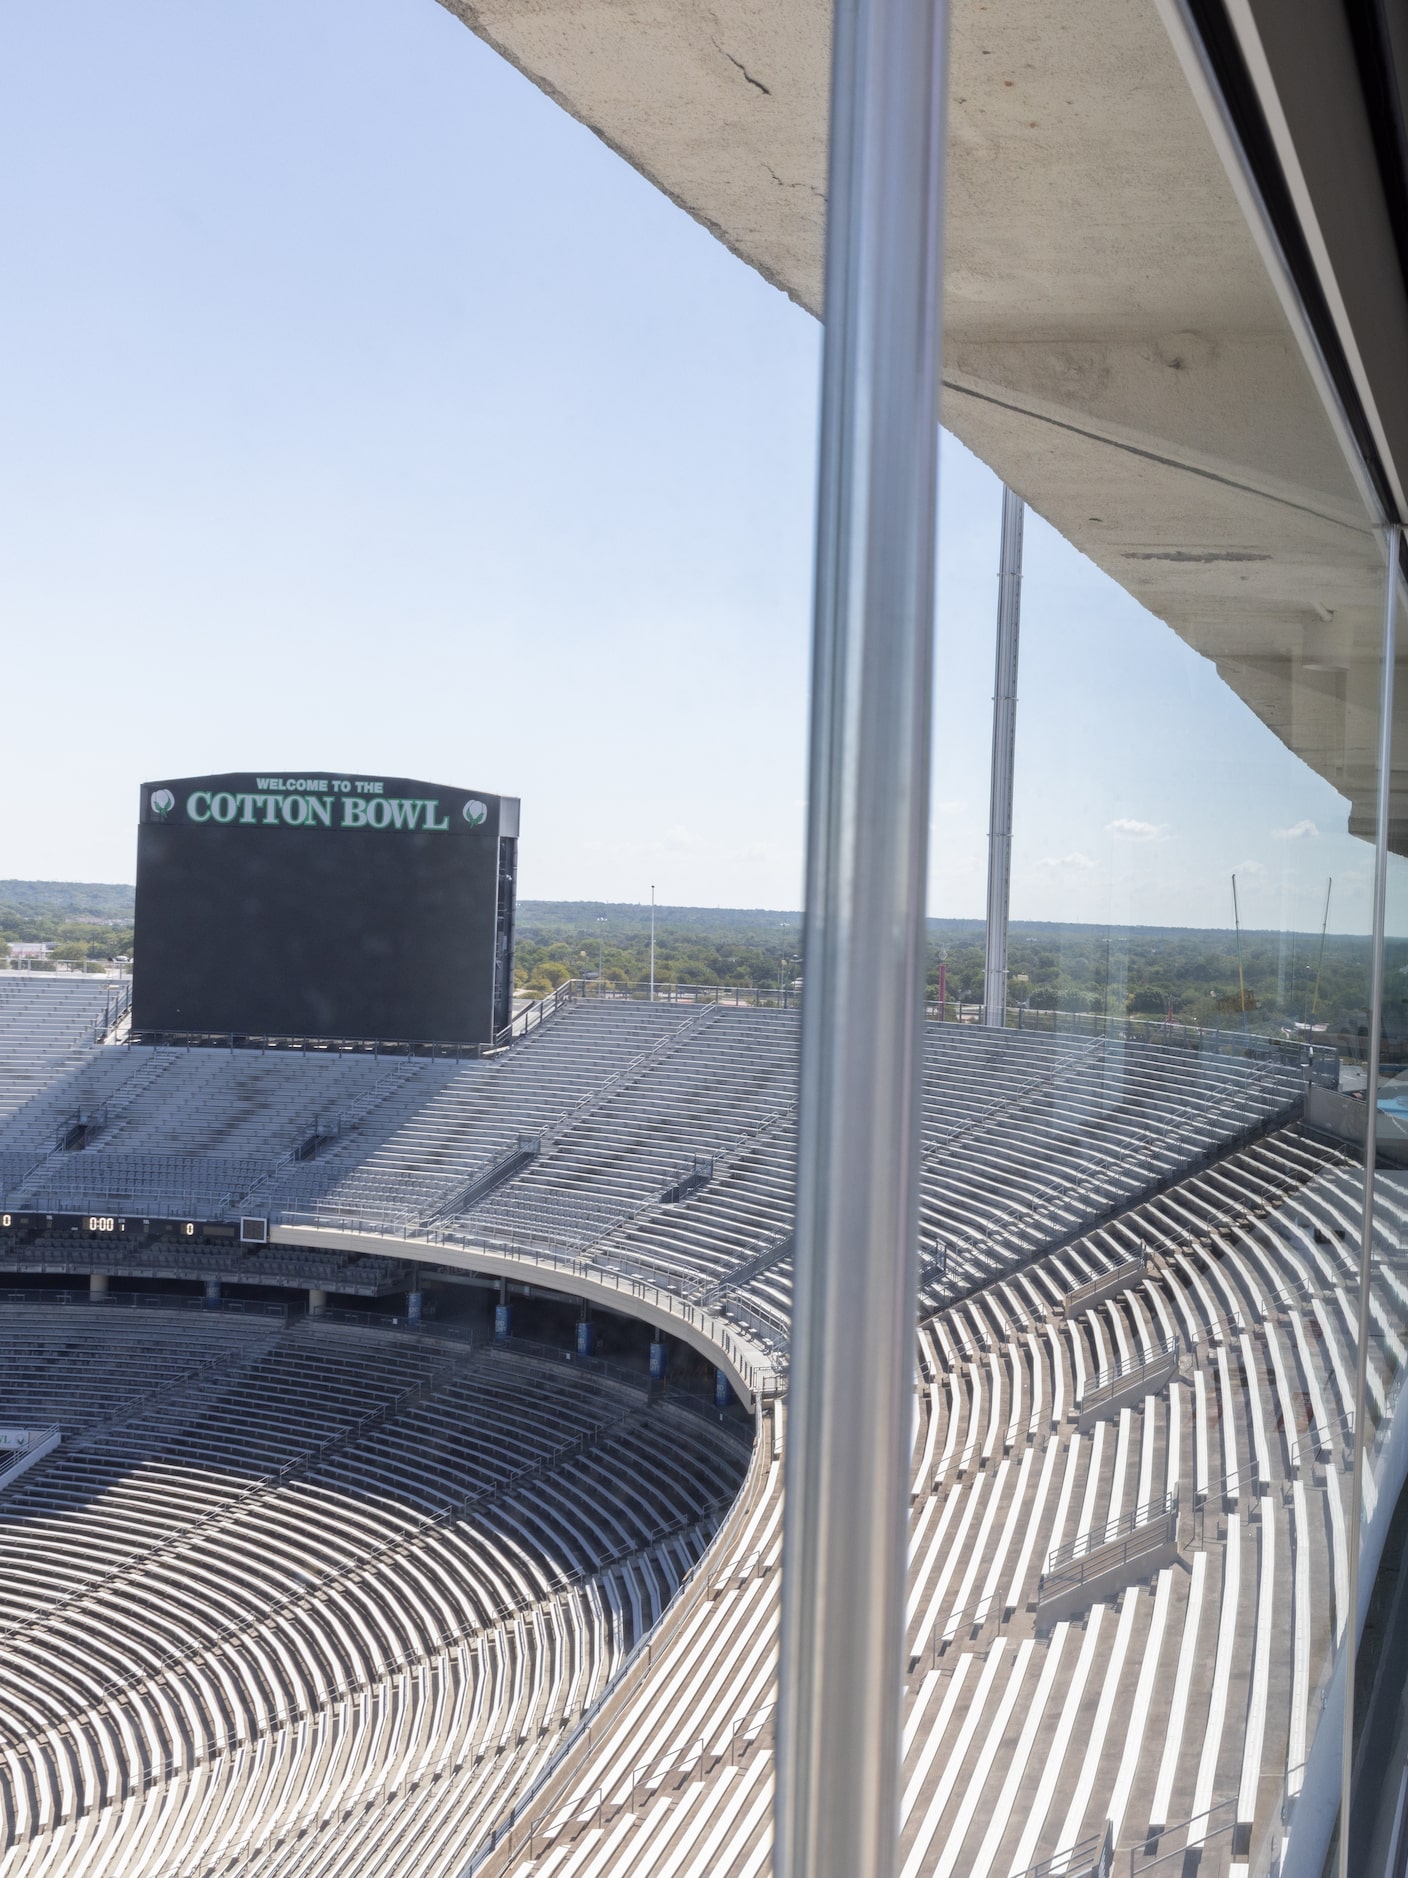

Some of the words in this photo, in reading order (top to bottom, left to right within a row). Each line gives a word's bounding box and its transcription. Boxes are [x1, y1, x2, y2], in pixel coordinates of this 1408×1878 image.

[256, 777, 328, 791] WELCOME
[332, 780, 352, 793] TO
[355, 781, 384, 794] THE
[186, 791, 335, 826] COTTON
[341, 797, 450, 831] BOWL
[2, 1214, 11, 1227] 0
[89, 1217, 114, 1231] 0:00
[186, 1223, 194, 1236] 0
